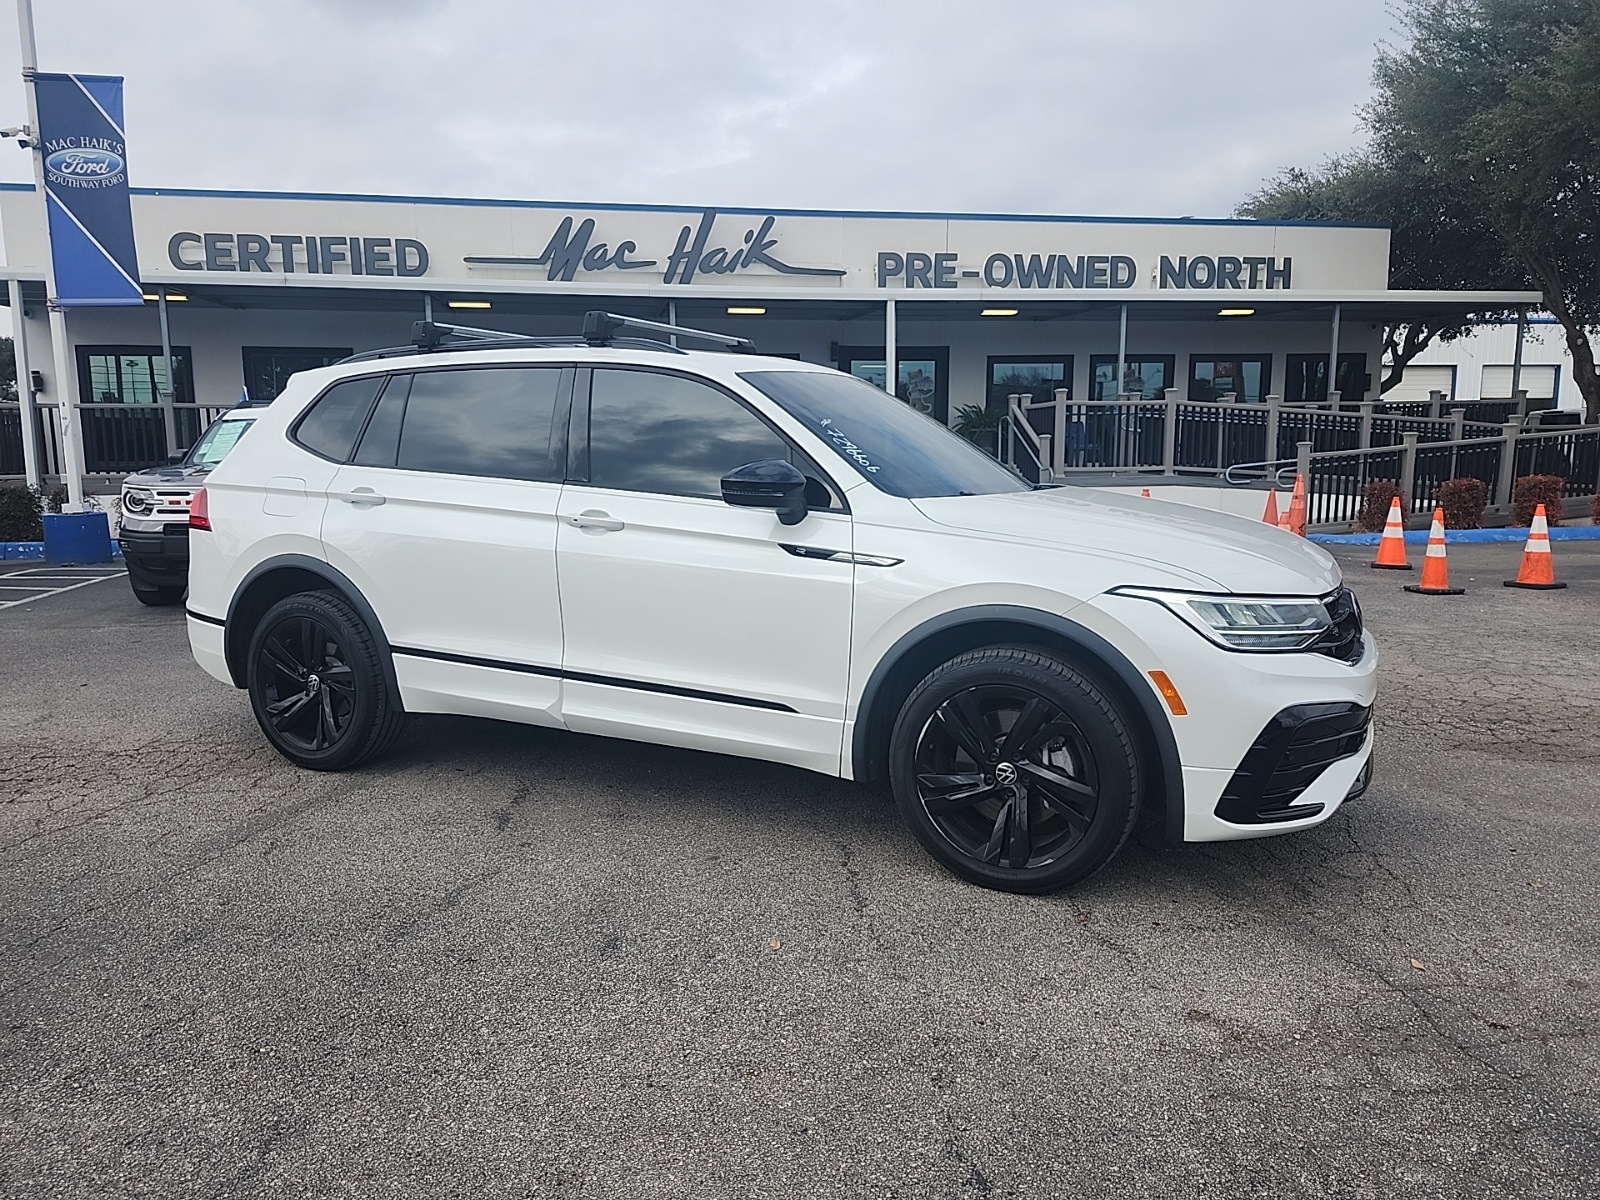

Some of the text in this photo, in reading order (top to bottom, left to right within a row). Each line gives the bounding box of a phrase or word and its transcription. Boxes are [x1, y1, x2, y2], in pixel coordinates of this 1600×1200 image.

[45, 137, 124, 154] MAC HAIK'S
[61, 153, 109, 174] Ford
[48, 173, 124, 188] SOUTHWAY FORD
[169, 232, 430, 277] CERTIFIED
[463, 208, 846, 285] Mac Haik
[877, 251, 1293, 290] PRE-OWNED NORTH
